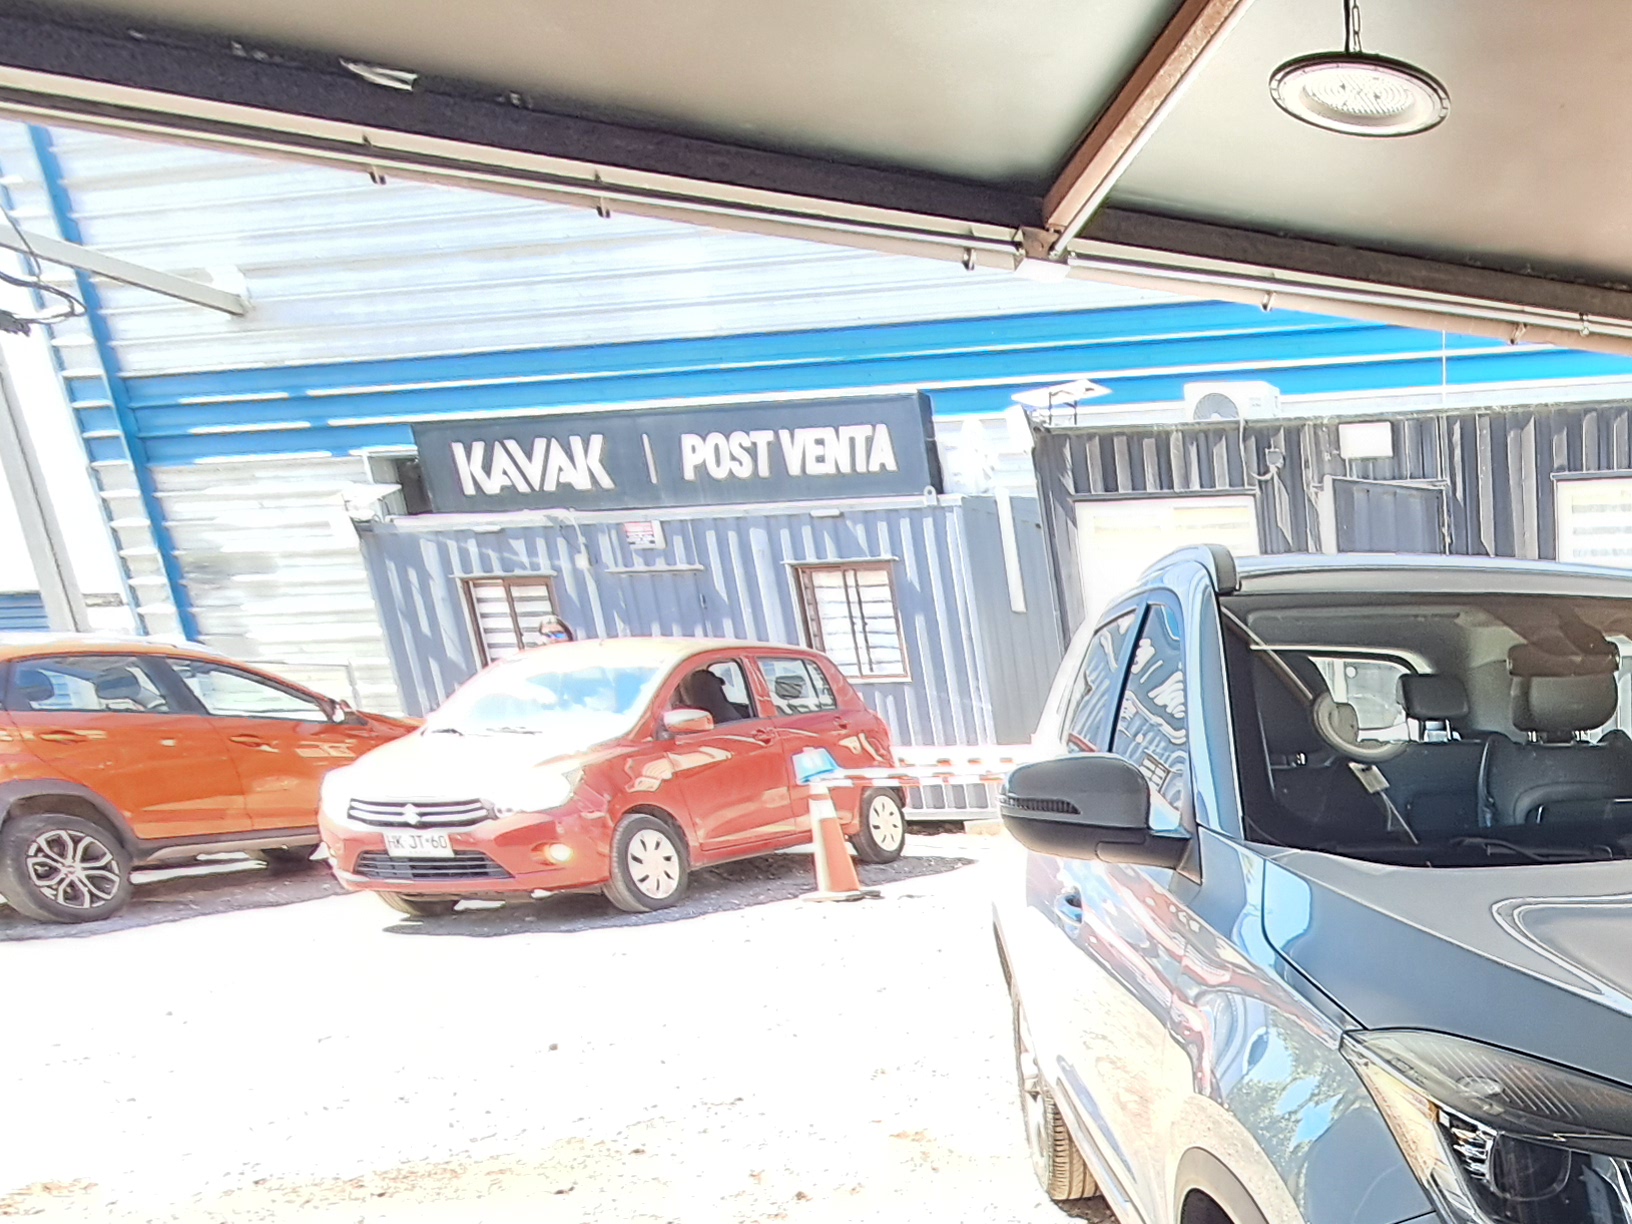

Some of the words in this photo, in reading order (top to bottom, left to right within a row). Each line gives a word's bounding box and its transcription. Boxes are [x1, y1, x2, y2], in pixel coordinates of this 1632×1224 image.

[452, 434, 615, 495] KAVAK
[681, 430, 774, 480] POST
[779, 424, 897, 476] VENTA
